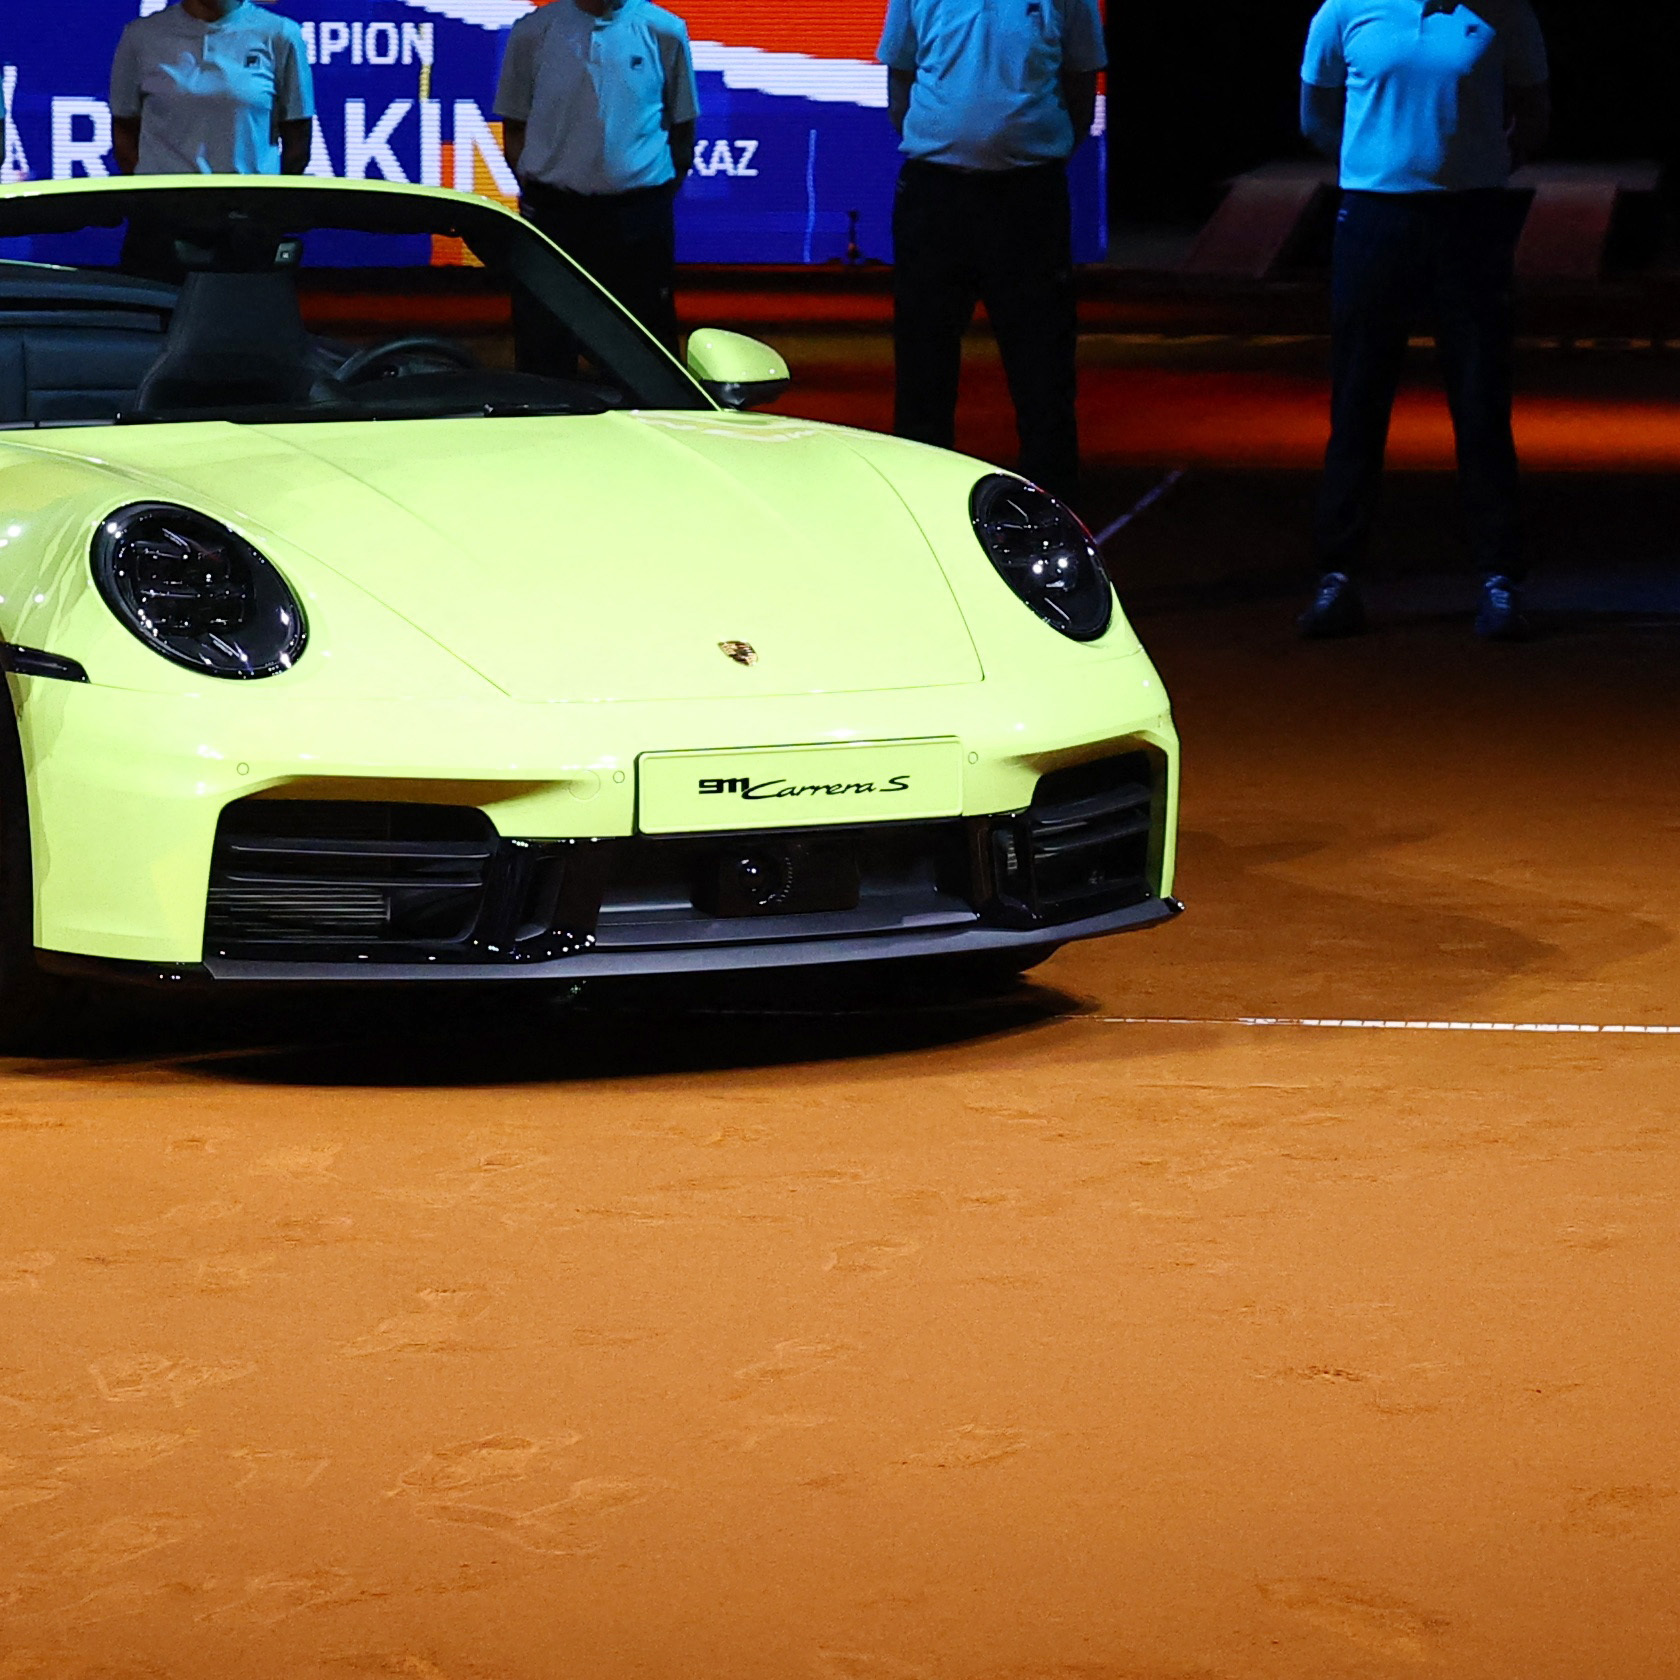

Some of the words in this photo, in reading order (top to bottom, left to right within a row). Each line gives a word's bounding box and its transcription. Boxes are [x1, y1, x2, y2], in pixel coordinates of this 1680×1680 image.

[301, 21, 435, 65] PION
[698, 777, 750, 796] 911
[741, 778, 877, 801] Carrera
[879, 774, 911, 794] S
